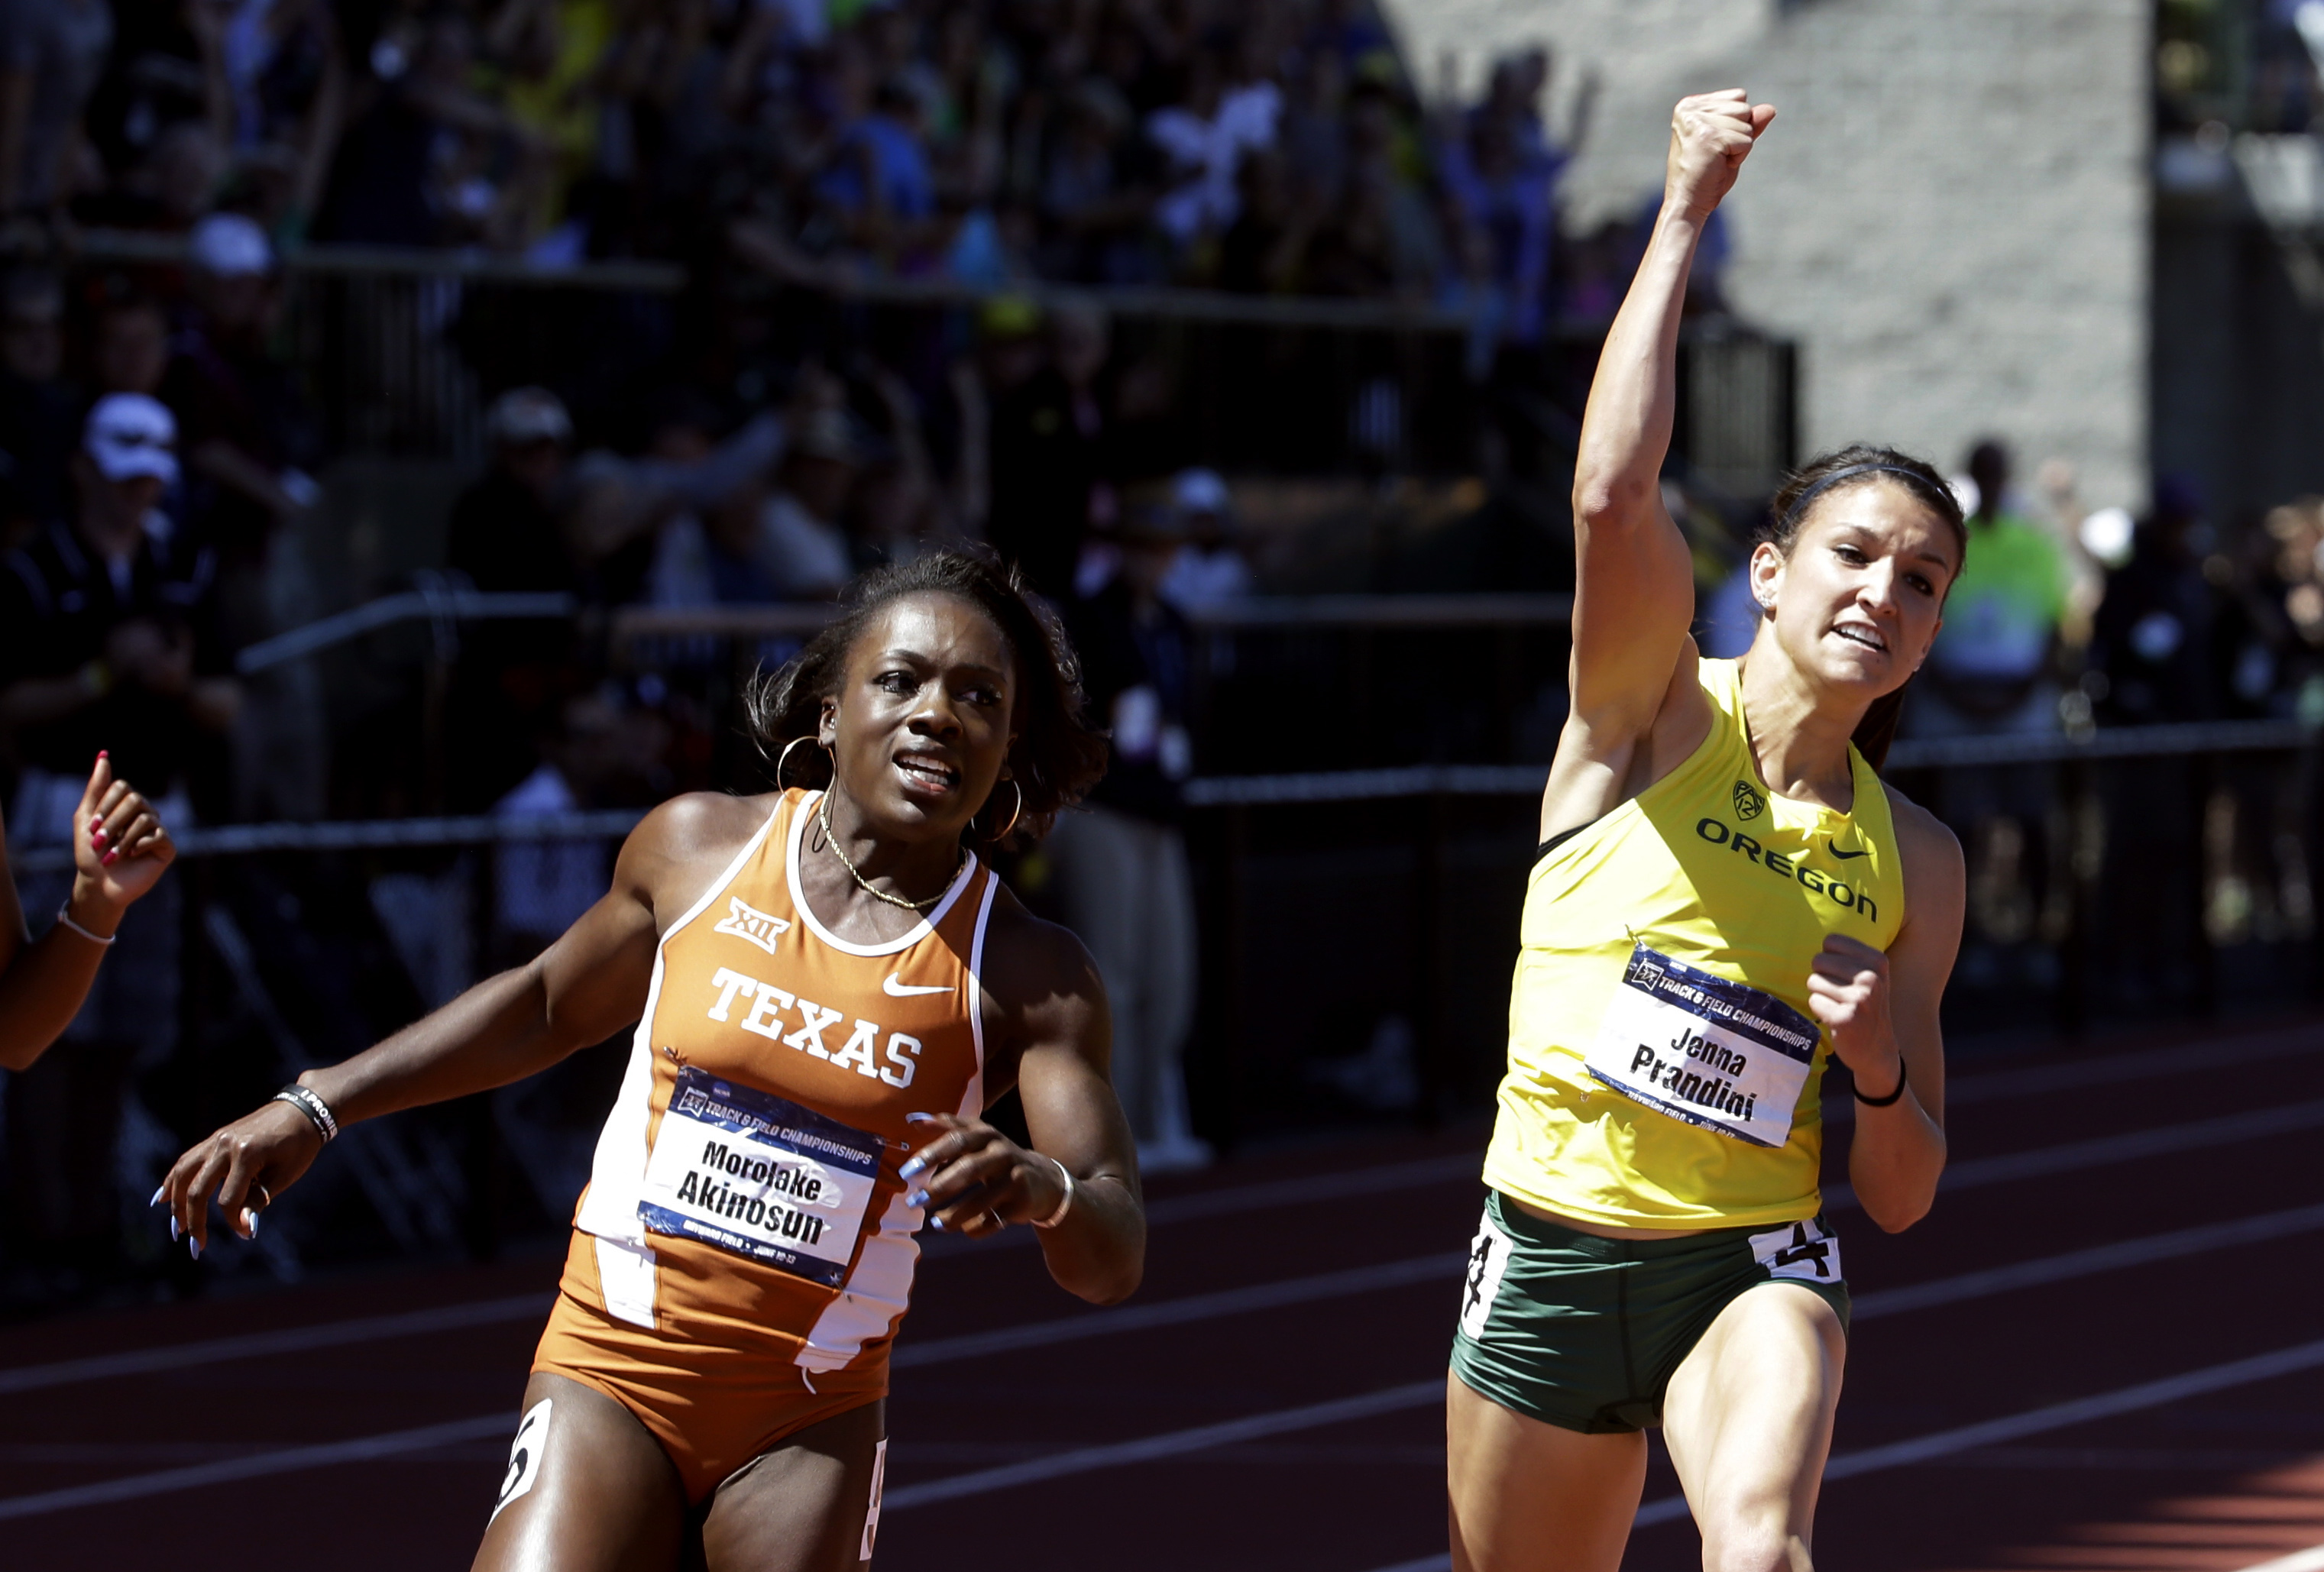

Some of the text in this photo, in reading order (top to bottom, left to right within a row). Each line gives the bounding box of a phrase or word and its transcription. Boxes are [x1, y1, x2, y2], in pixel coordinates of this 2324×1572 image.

[707, 966, 922, 1089] TEXAS
[1659, 976, 1812, 1051] TRACK & FIELD CHAMPIONSHIPS
[1630, 1043, 1757, 1122] Prandini
[1671, 1027, 1747, 1078] Jenna
[306, 1094, 338, 1140] PROMIS
[706, 1101, 872, 1165] TRACK & FIELD CHAMPIONSHIPS
[701, 1140, 823, 1203] Morolake
[677, 1170, 825, 1245] Akinosun
[1775, 1221, 1830, 1277] 4
